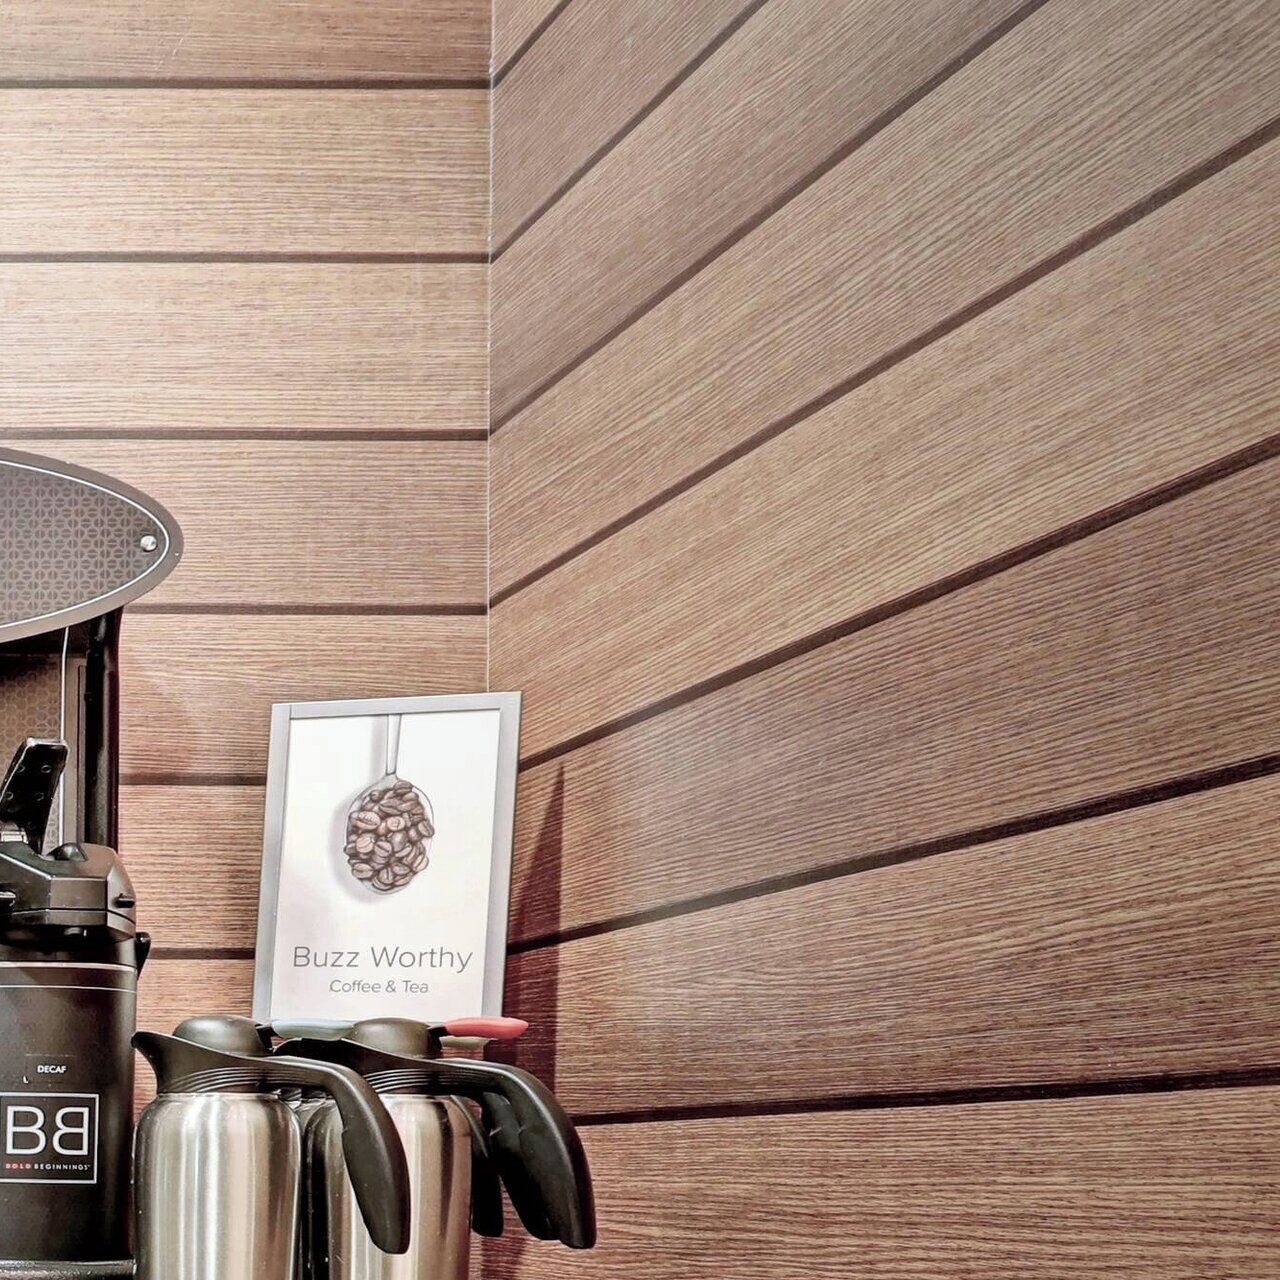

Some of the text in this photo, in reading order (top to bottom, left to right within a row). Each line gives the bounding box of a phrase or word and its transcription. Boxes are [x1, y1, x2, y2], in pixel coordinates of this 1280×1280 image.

[293, 946, 473, 974] Buzz Worthy
[329, 979, 429, 993] Coffee & Tea
[37, 1065, 67, 1074] DECAF
